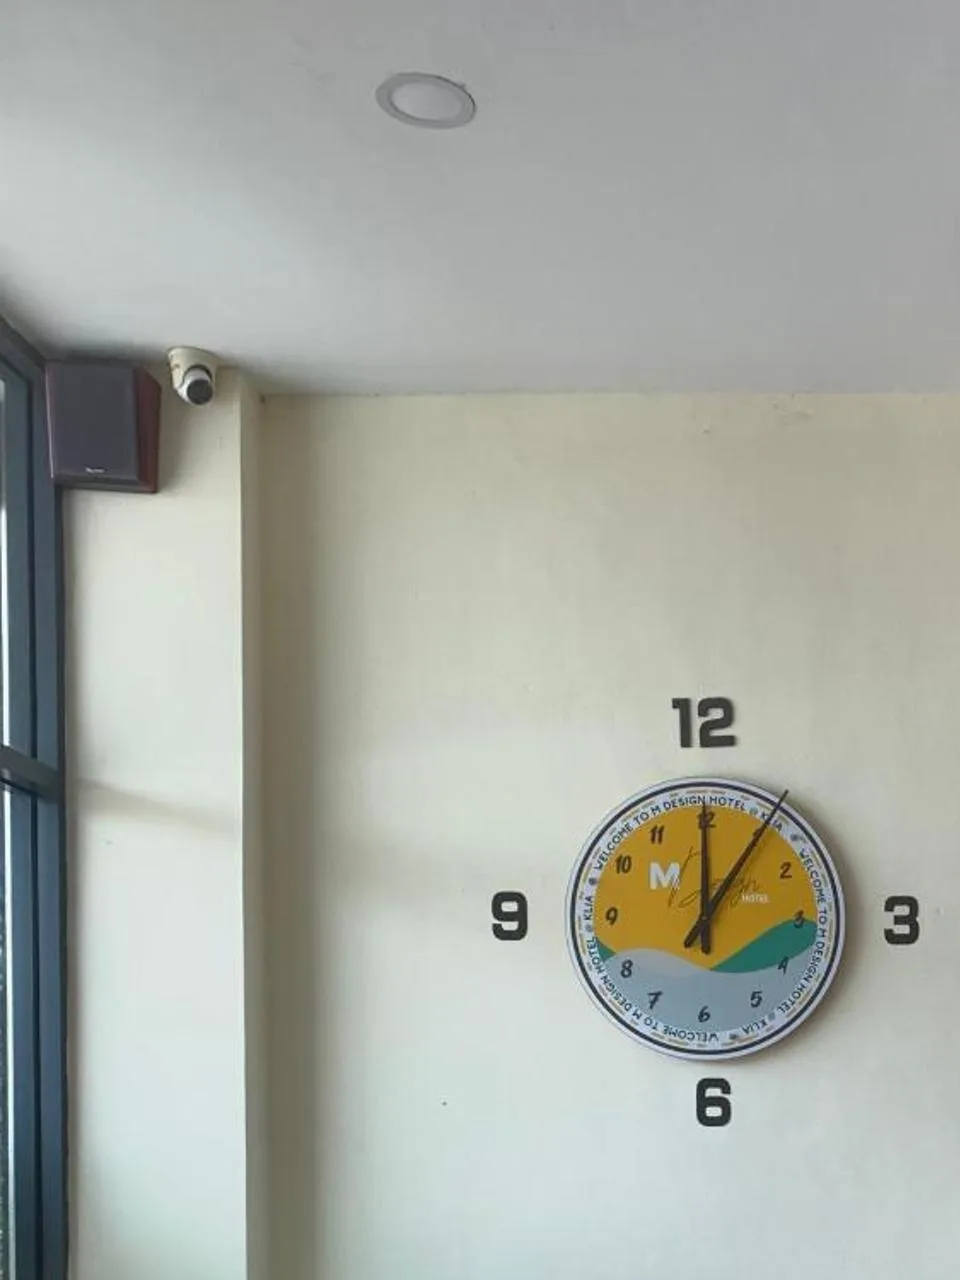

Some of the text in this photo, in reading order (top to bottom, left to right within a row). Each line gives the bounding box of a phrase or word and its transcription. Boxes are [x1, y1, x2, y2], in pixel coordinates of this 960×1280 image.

[672, 697, 737, 748] 12
[594, 822, 634, 871] WELCOME
[633, 811, 650, 825] TO
[651, 805, 662, 816] M
[663, 796, 706, 810] DESIGN
[710, 796, 745, 811] HOTEL
[760, 811, 783, 832] KIA
[650, 824, 665, 845] 11
[615, 855, 632, 875] 10
[780, 861, 793, 880] 2
[799, 847, 827, 903] WELCOME
[650, 861, 681, 891] M
[491, 891, 528, 941] 9
[582, 895, 594, 921] KLIA
[605, 906, 618, 926] 9
[818, 907, 828, 925] TO
[793, 910, 805, 929] 3
[883, 895, 920, 946] 3
[819, 928, 828, 938] M
[587, 935, 606, 974] HOTEL
[803, 941, 826, 984] DESIGN
[620, 959, 634, 979] 8
[777, 956, 790, 977] 4
[600, 975, 633, 1012] DESIGN
[647, 990, 664, 1010] 7
[750, 991, 763, 1008] 5
[777, 983, 806, 1014] HOTEL
[632, 1008, 642, 1020] M
[644, 1016, 658, 1031] TO
[698, 1005, 711, 1023] 6
[663, 1024, 719, 1042] WELCOME
[742, 1017, 769, 1036] KLIA
[696, 1077, 732, 1127] 6
